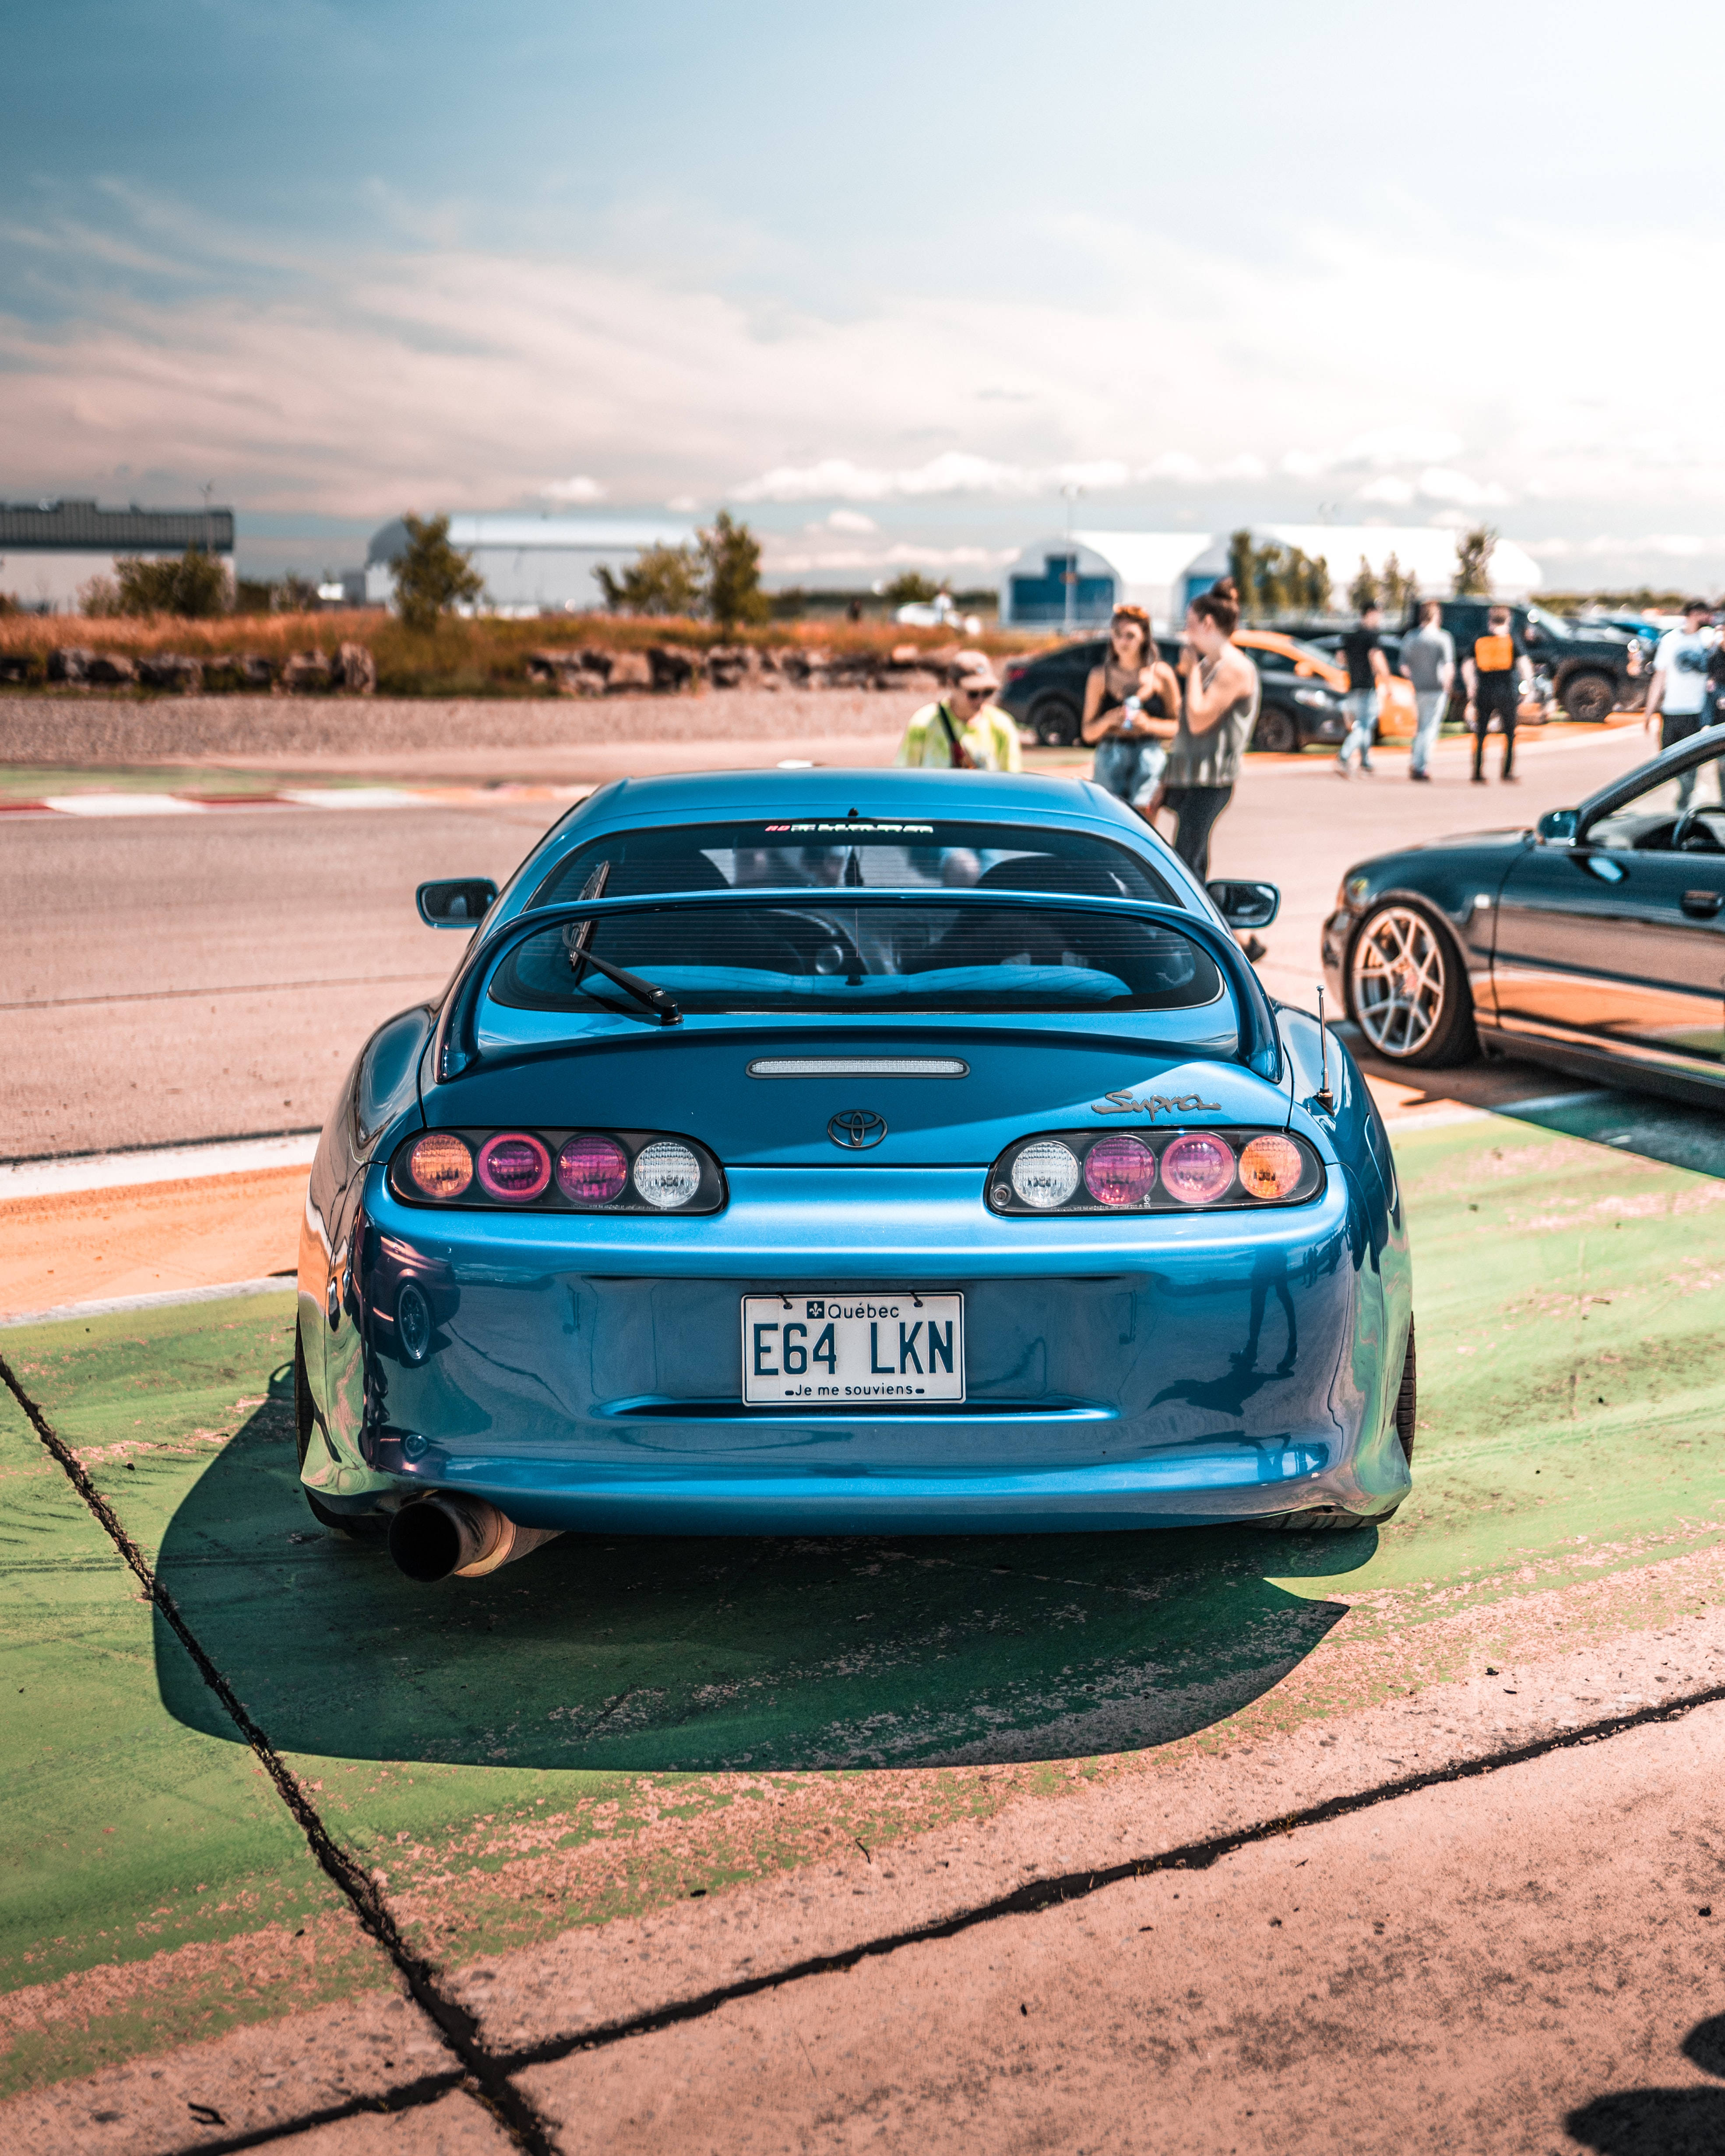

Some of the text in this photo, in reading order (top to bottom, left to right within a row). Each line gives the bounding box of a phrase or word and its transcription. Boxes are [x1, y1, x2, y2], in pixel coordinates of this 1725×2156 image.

[1091, 1089, 1222, 1122] Supra
[827, 1302, 900, 1319] Québec
[753, 1320, 954, 1375] E64 LKN
[795, 1382, 913, 1396] Je me souviens
